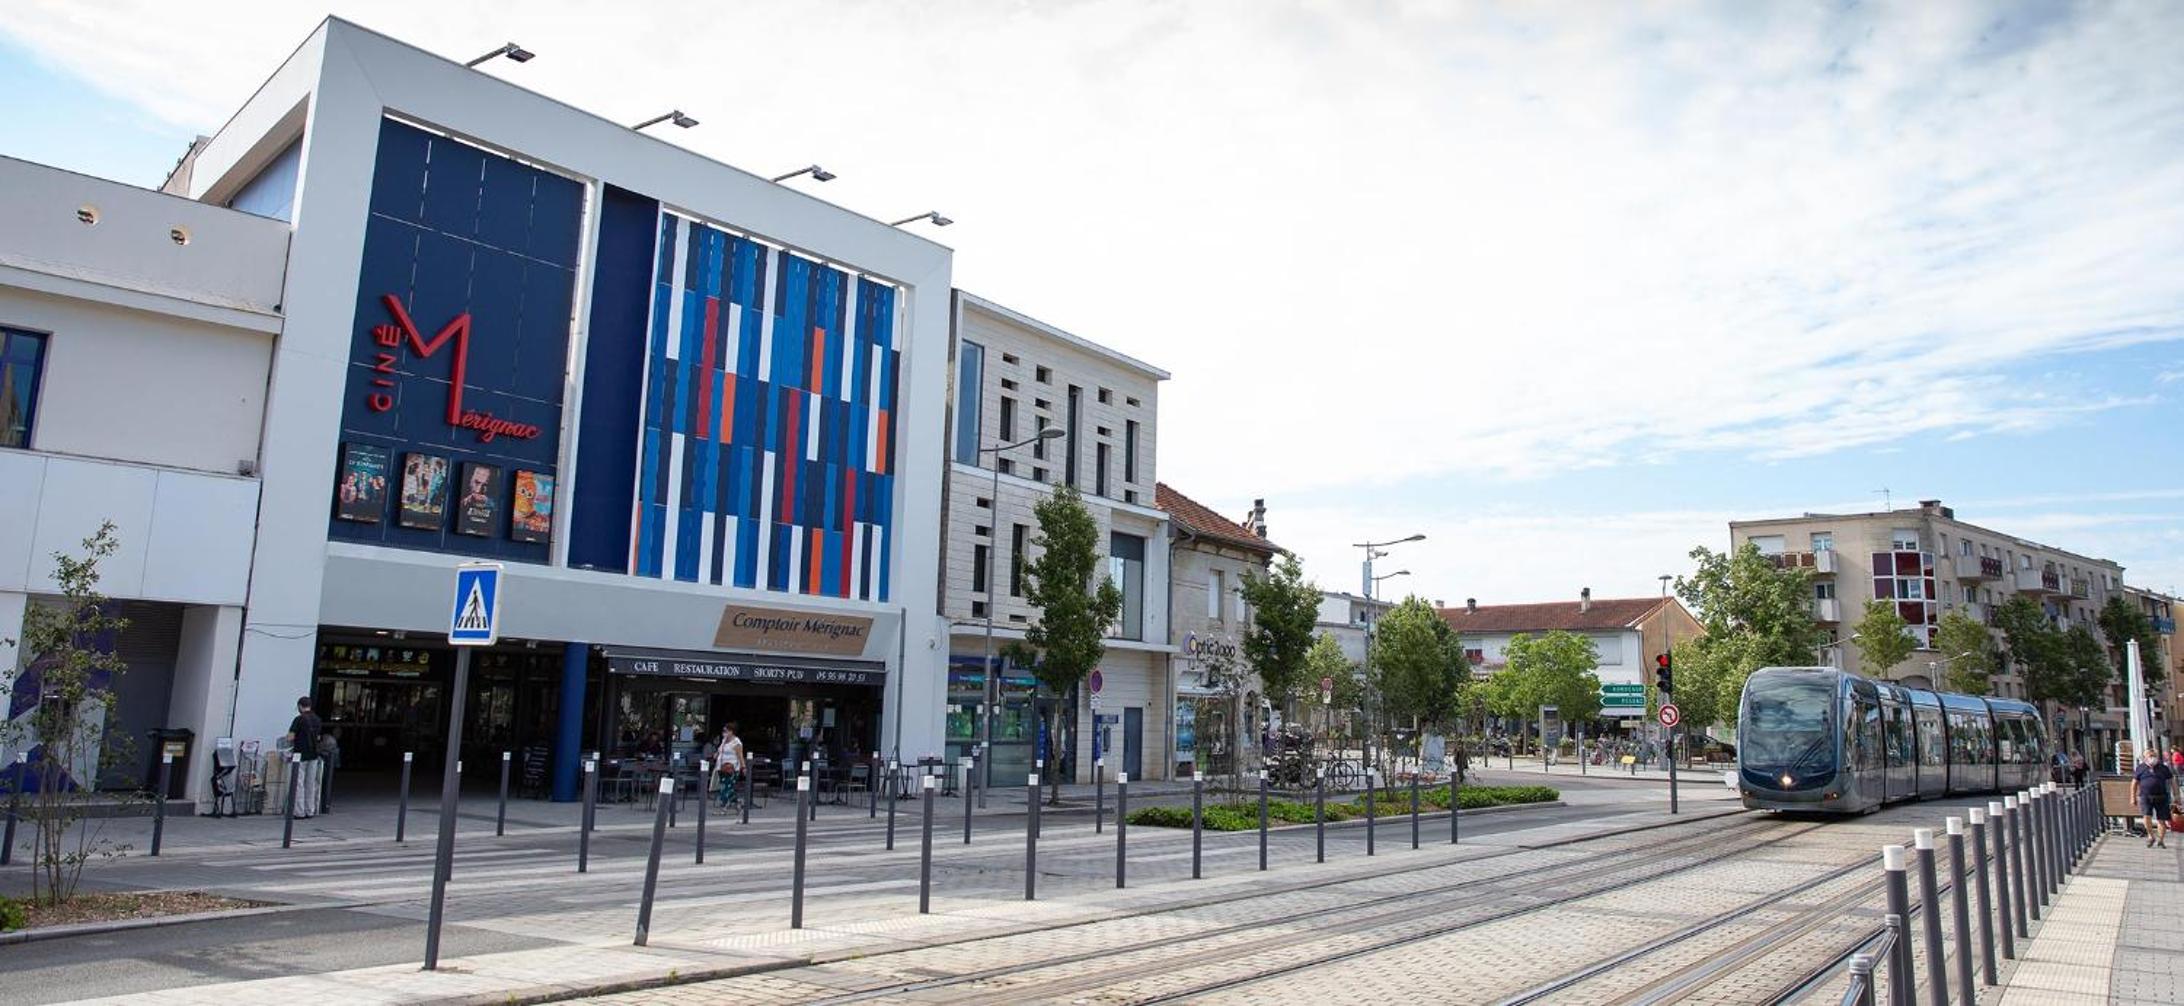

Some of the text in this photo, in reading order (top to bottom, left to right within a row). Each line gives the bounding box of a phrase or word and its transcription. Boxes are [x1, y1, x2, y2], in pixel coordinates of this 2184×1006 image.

[369, 324, 401, 413] CINÉ
[733, 612, 863, 640] Comptoir Mérignac
[674, 663, 740, 676] RESTAURATION
